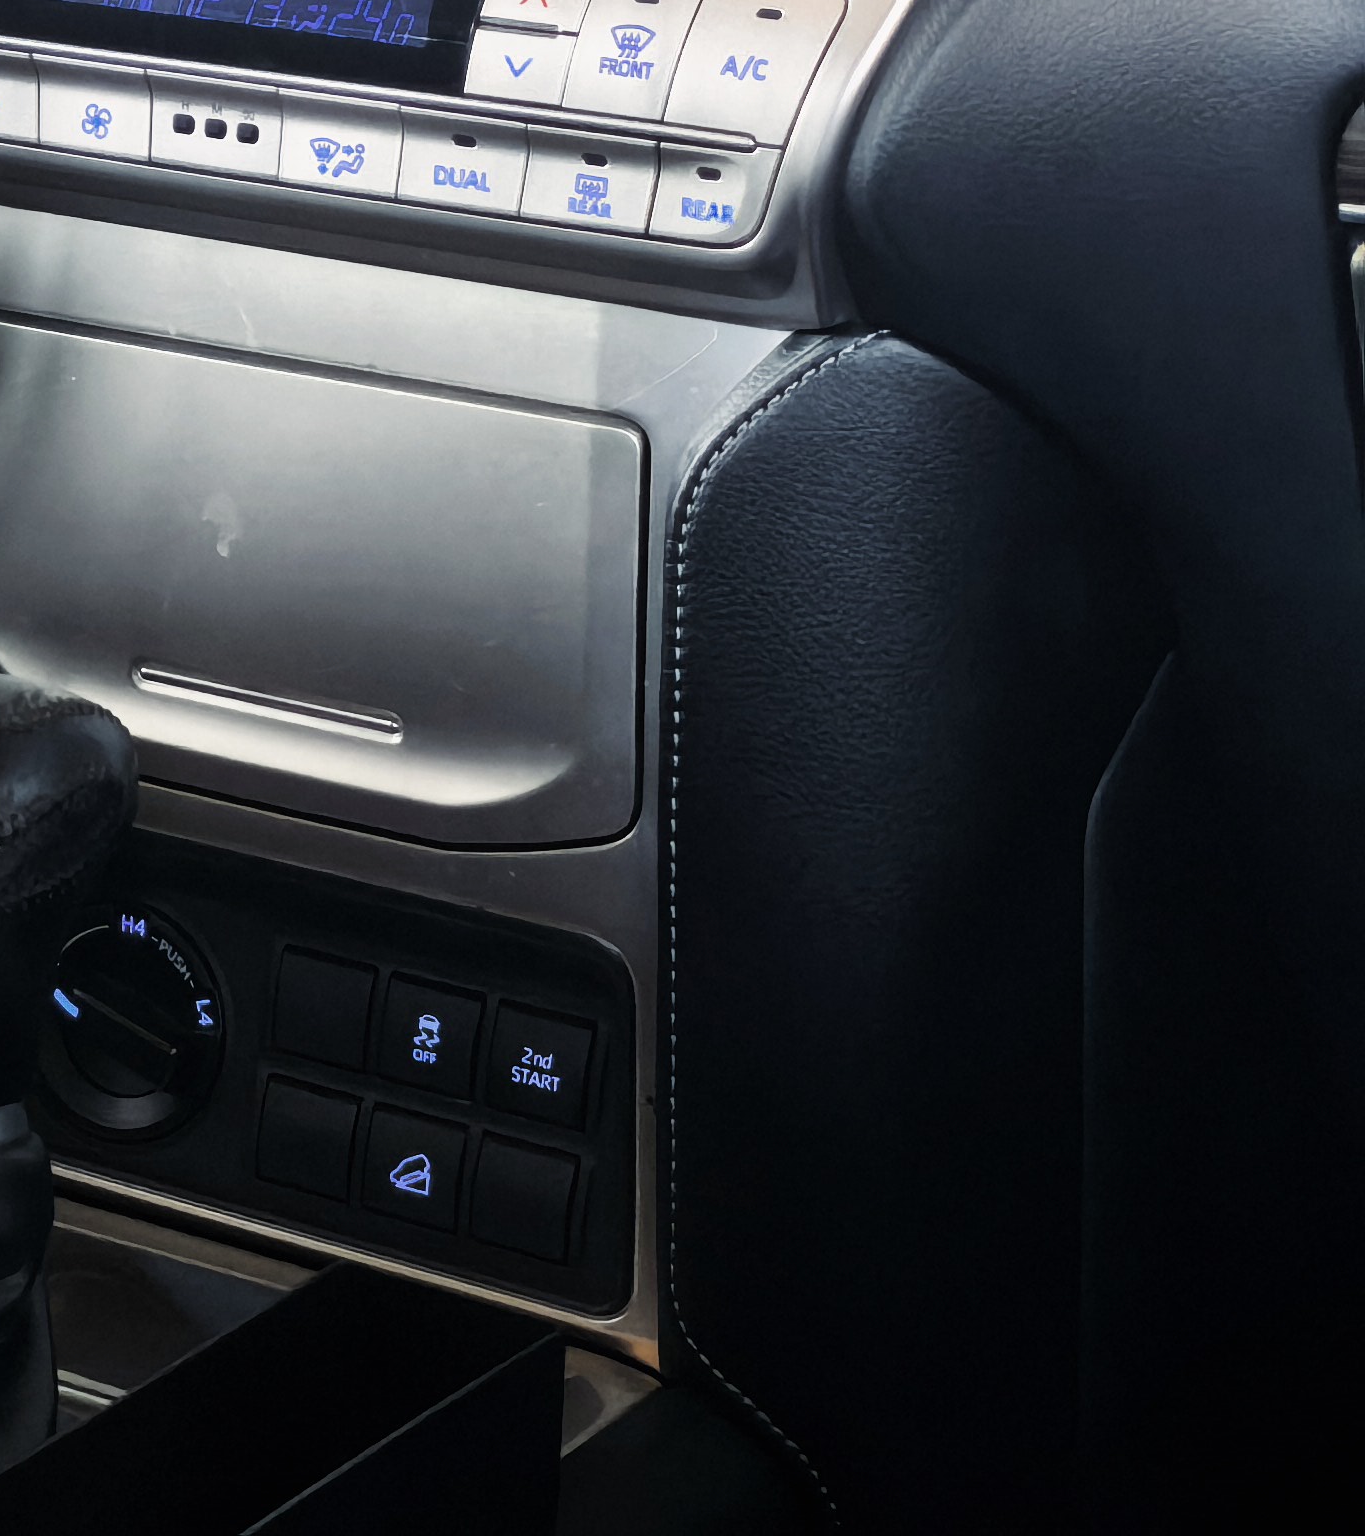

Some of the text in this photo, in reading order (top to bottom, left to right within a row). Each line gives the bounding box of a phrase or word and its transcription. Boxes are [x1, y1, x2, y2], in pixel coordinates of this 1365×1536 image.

[599, 56, 655, 81] FRONT
[720, 54, 769, 82] A/C
[432, 164, 491, 193] DUAL
[566, 196, 613, 220] REAR
[680, 197, 736, 226] REAR
[121, 914, 146, 937] H4
[195, 999, 214, 1026] L4
[413, 1047, 437, 1064] OFF
[520, 1046, 553, 1071] 2nd
[510, 1064, 561, 1093] START
